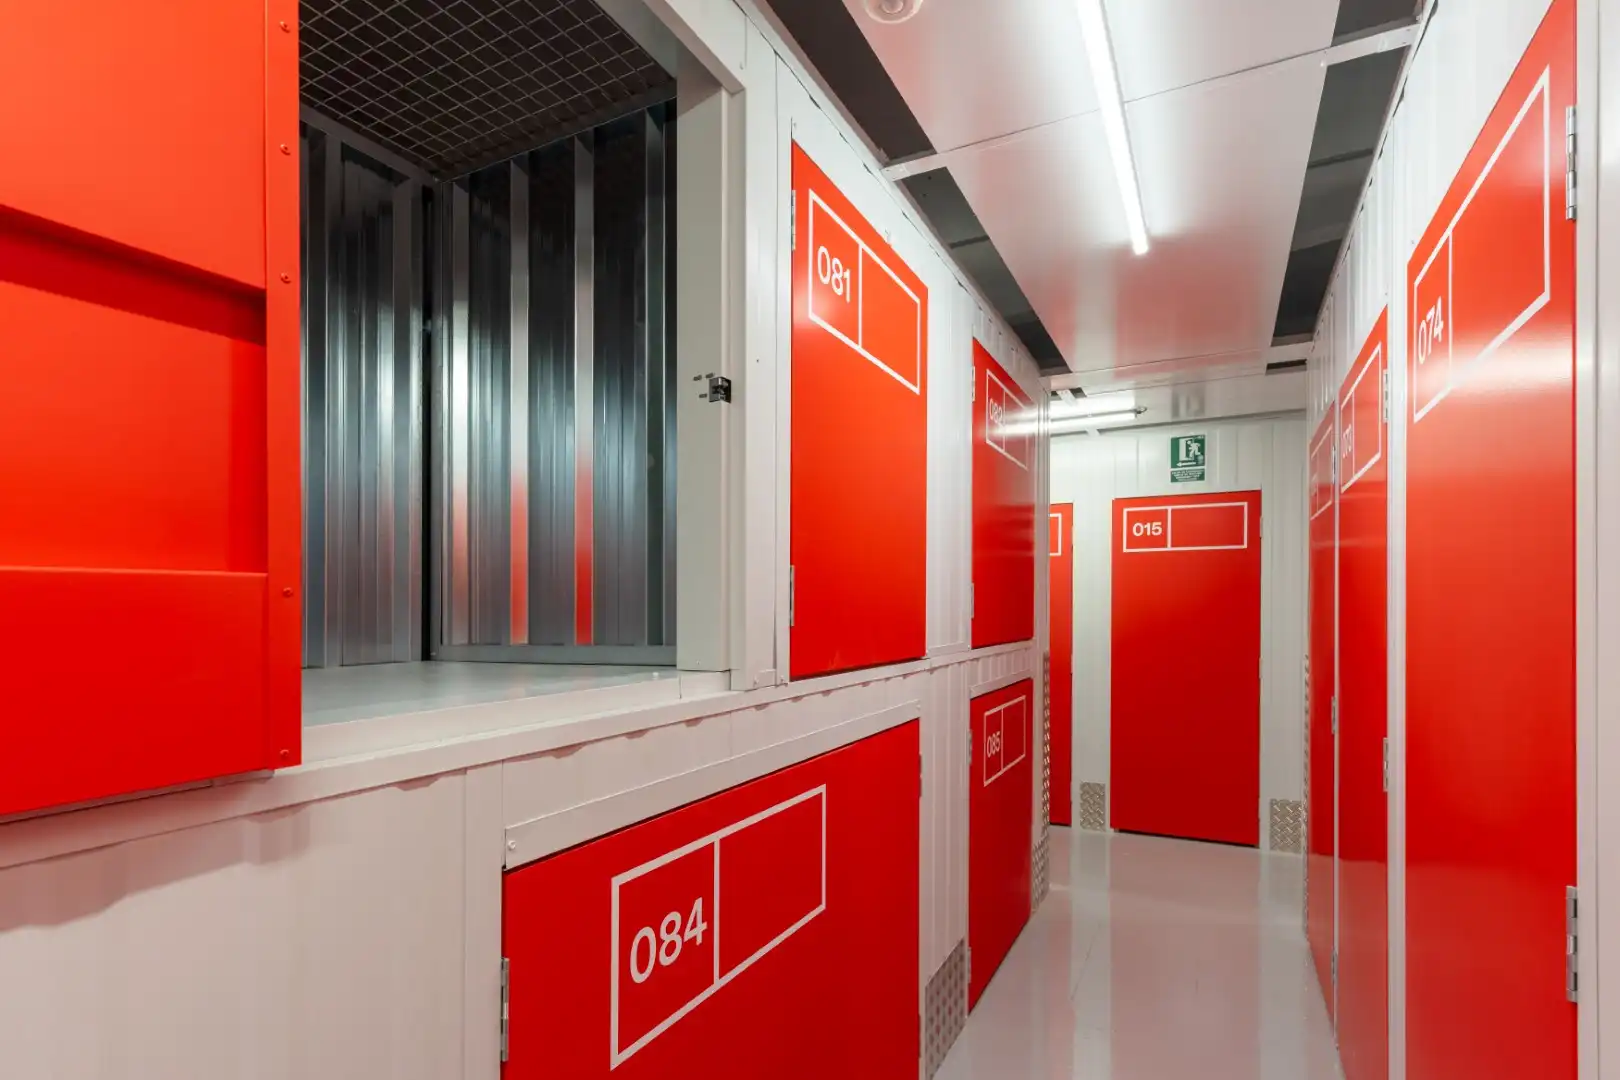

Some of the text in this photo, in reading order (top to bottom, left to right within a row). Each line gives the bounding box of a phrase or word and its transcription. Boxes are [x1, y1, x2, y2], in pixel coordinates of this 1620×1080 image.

[817, 245, 851, 304] 081
[1418, 295, 1444, 365] 074
[989, 398, 1003, 426] 082
[1132, 522, 1163, 537] 015
[986, 730, 1001, 758] 085
[630, 896, 708, 984] 084
